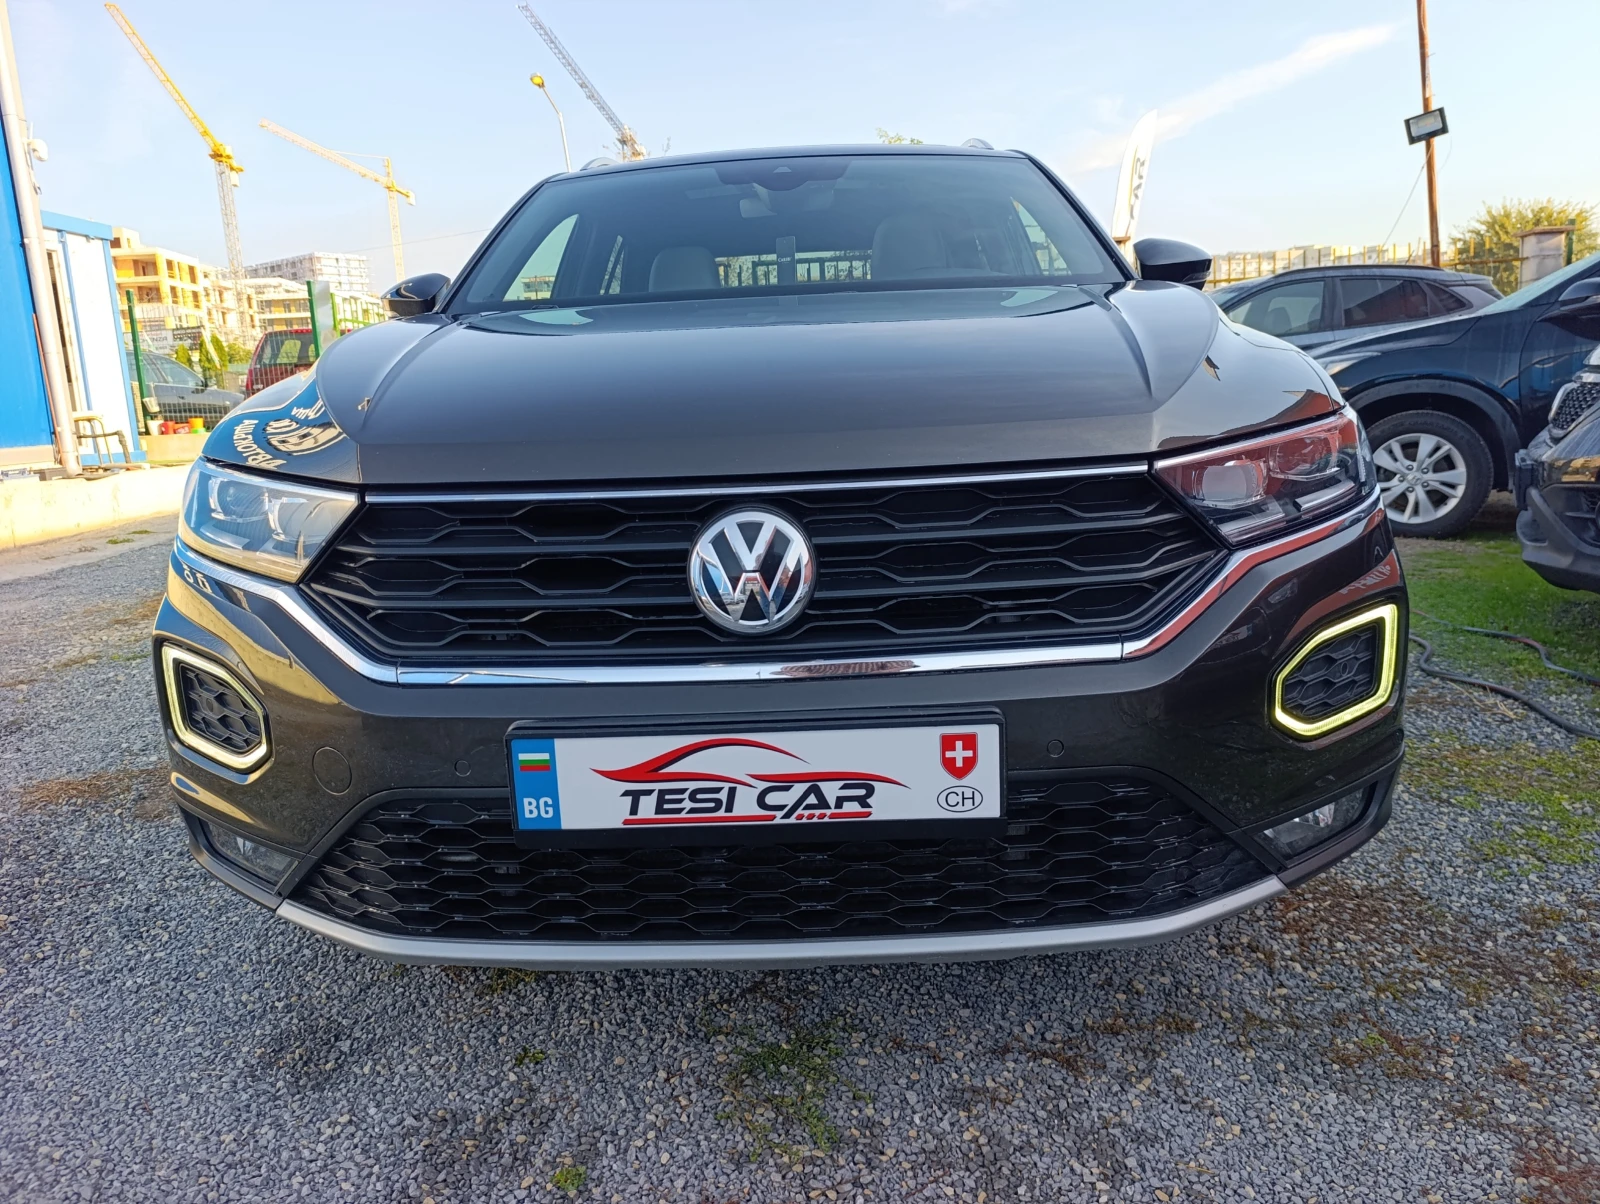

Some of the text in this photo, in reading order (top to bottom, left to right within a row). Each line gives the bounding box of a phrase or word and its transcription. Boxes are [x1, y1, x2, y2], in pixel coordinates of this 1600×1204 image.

[523, 796, 554, 819] BG
[619, 781, 876, 819] TESI CAR
[945, 790, 976, 807] CH
